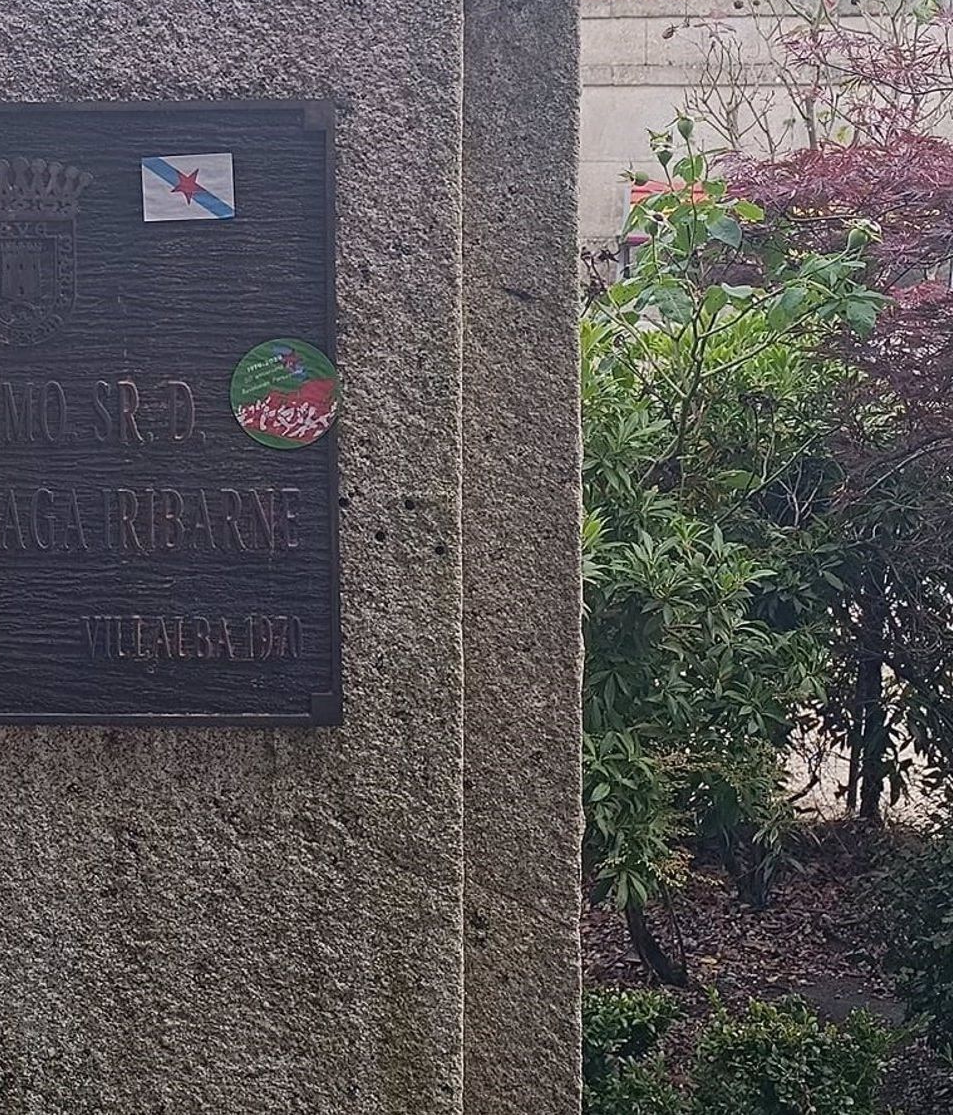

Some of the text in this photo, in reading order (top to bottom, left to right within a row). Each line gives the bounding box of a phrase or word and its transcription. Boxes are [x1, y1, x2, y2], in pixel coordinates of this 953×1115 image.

[102, 486, 300, 552] IRIBARNE
[80, 614, 304, 660] VILLALBA 1970
